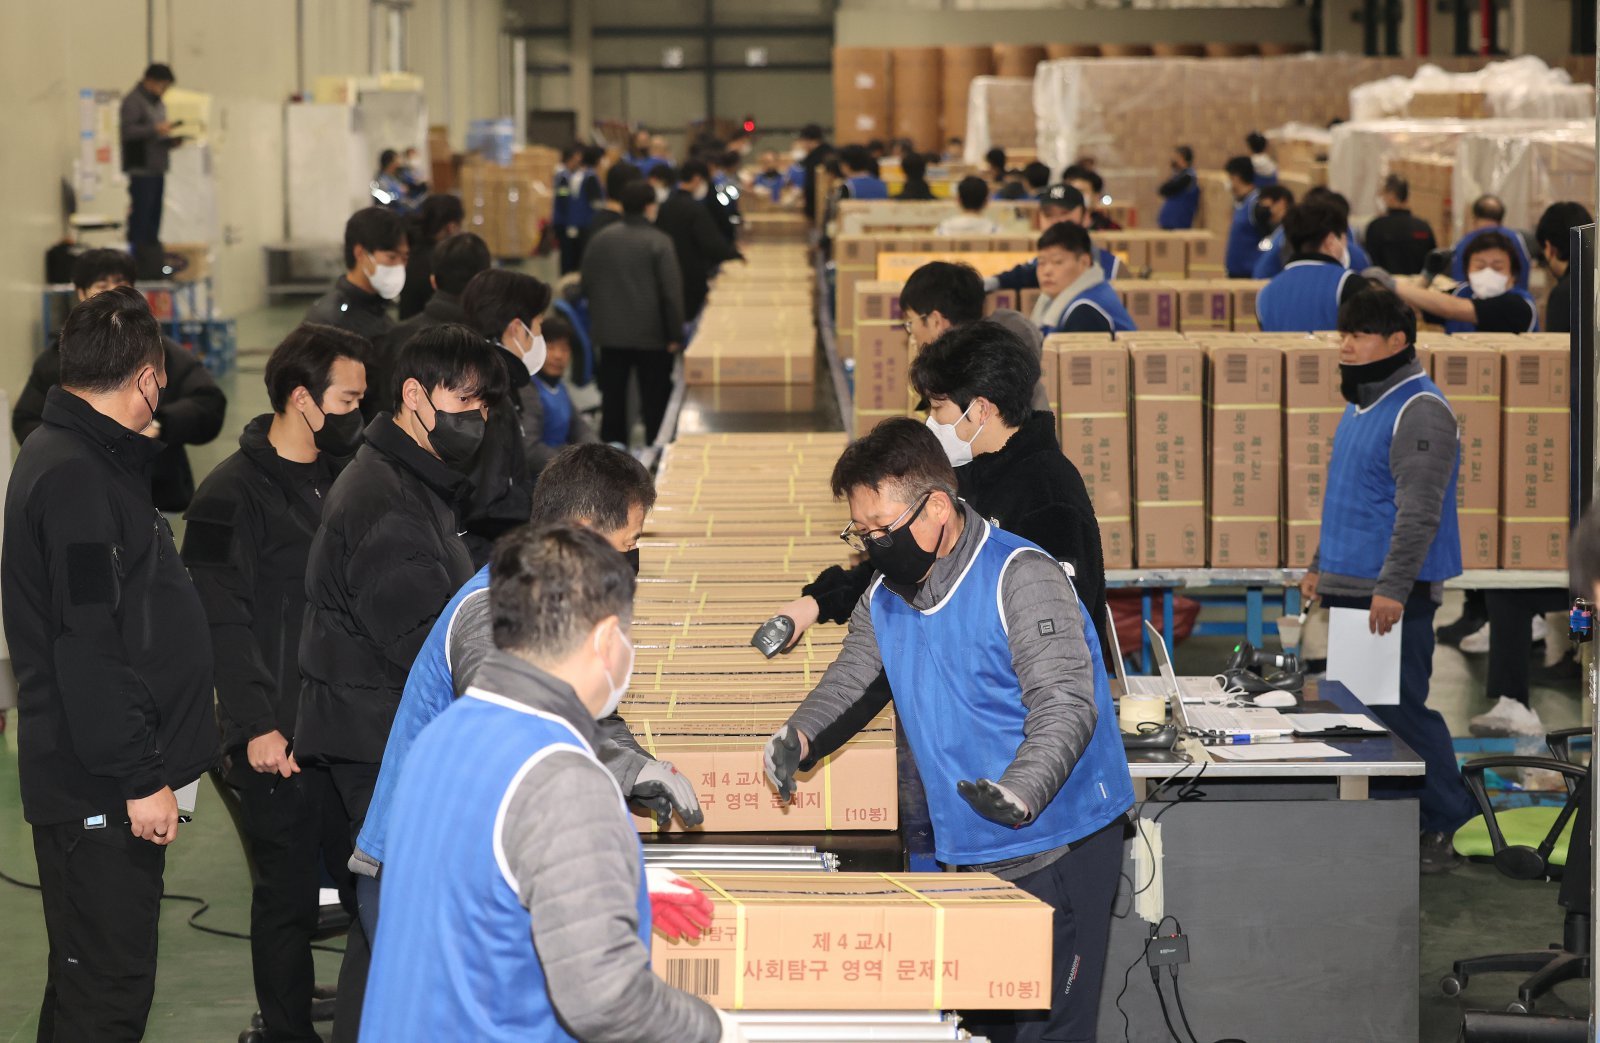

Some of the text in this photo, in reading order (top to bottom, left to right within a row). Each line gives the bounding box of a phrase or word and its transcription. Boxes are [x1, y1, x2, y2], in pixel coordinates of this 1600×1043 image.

[701, 771, 767, 788] 제 4 교시
[725, 793, 759, 810] 영역
[812, 932, 892, 952] 제 4 교시
[743, 959, 960, 982] 사회탐구 영역 문제지
